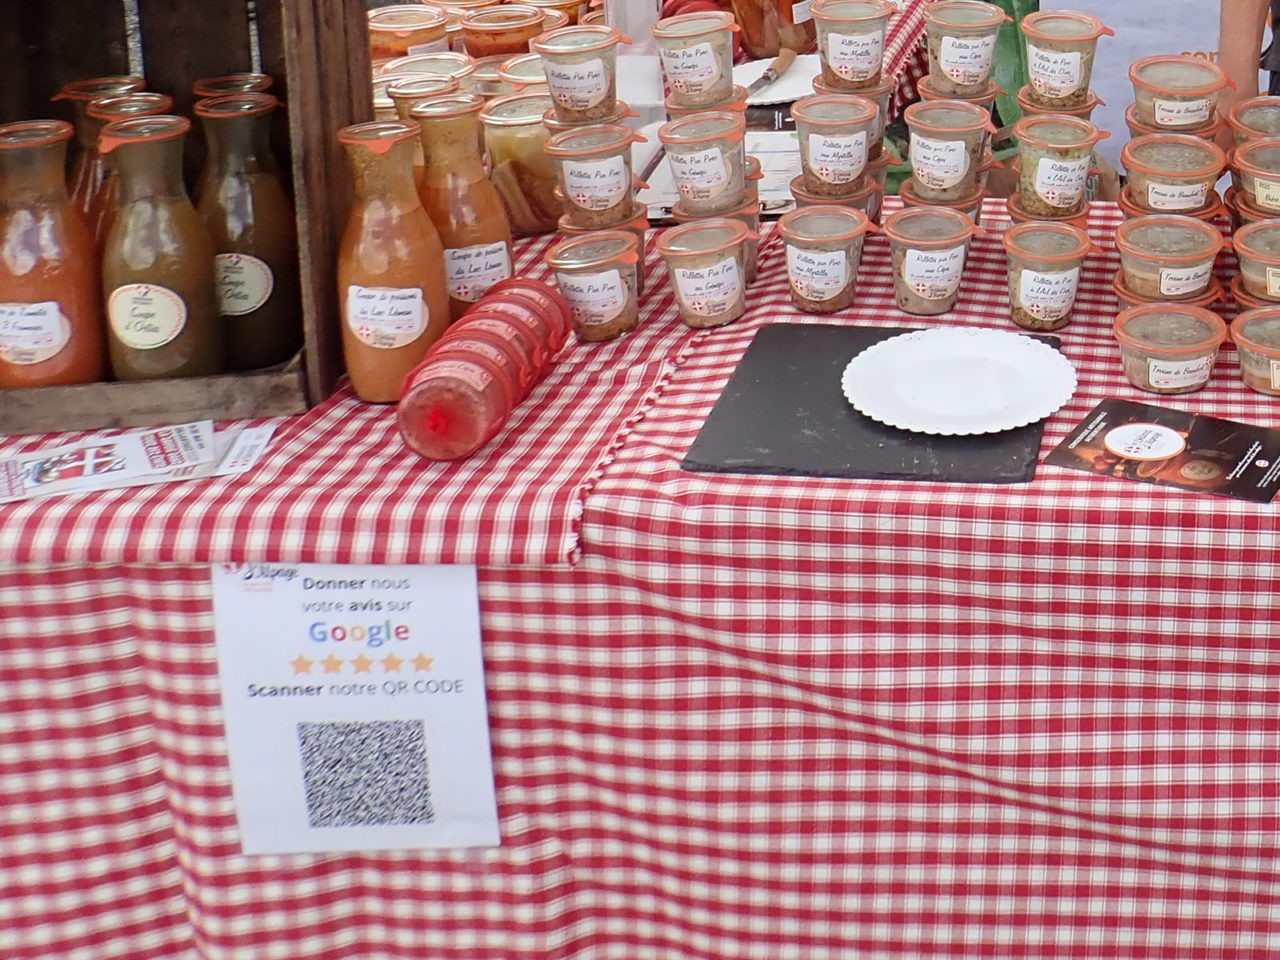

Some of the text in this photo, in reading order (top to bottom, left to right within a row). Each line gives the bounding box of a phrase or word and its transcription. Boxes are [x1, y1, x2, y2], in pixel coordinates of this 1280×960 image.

[303, 575, 410, 590] Donner nous
[303, 597, 413, 612] votre avis sur
[308, 619, 410, 648] Google
[247, 678, 464, 697] Scanner notre QR CODE
